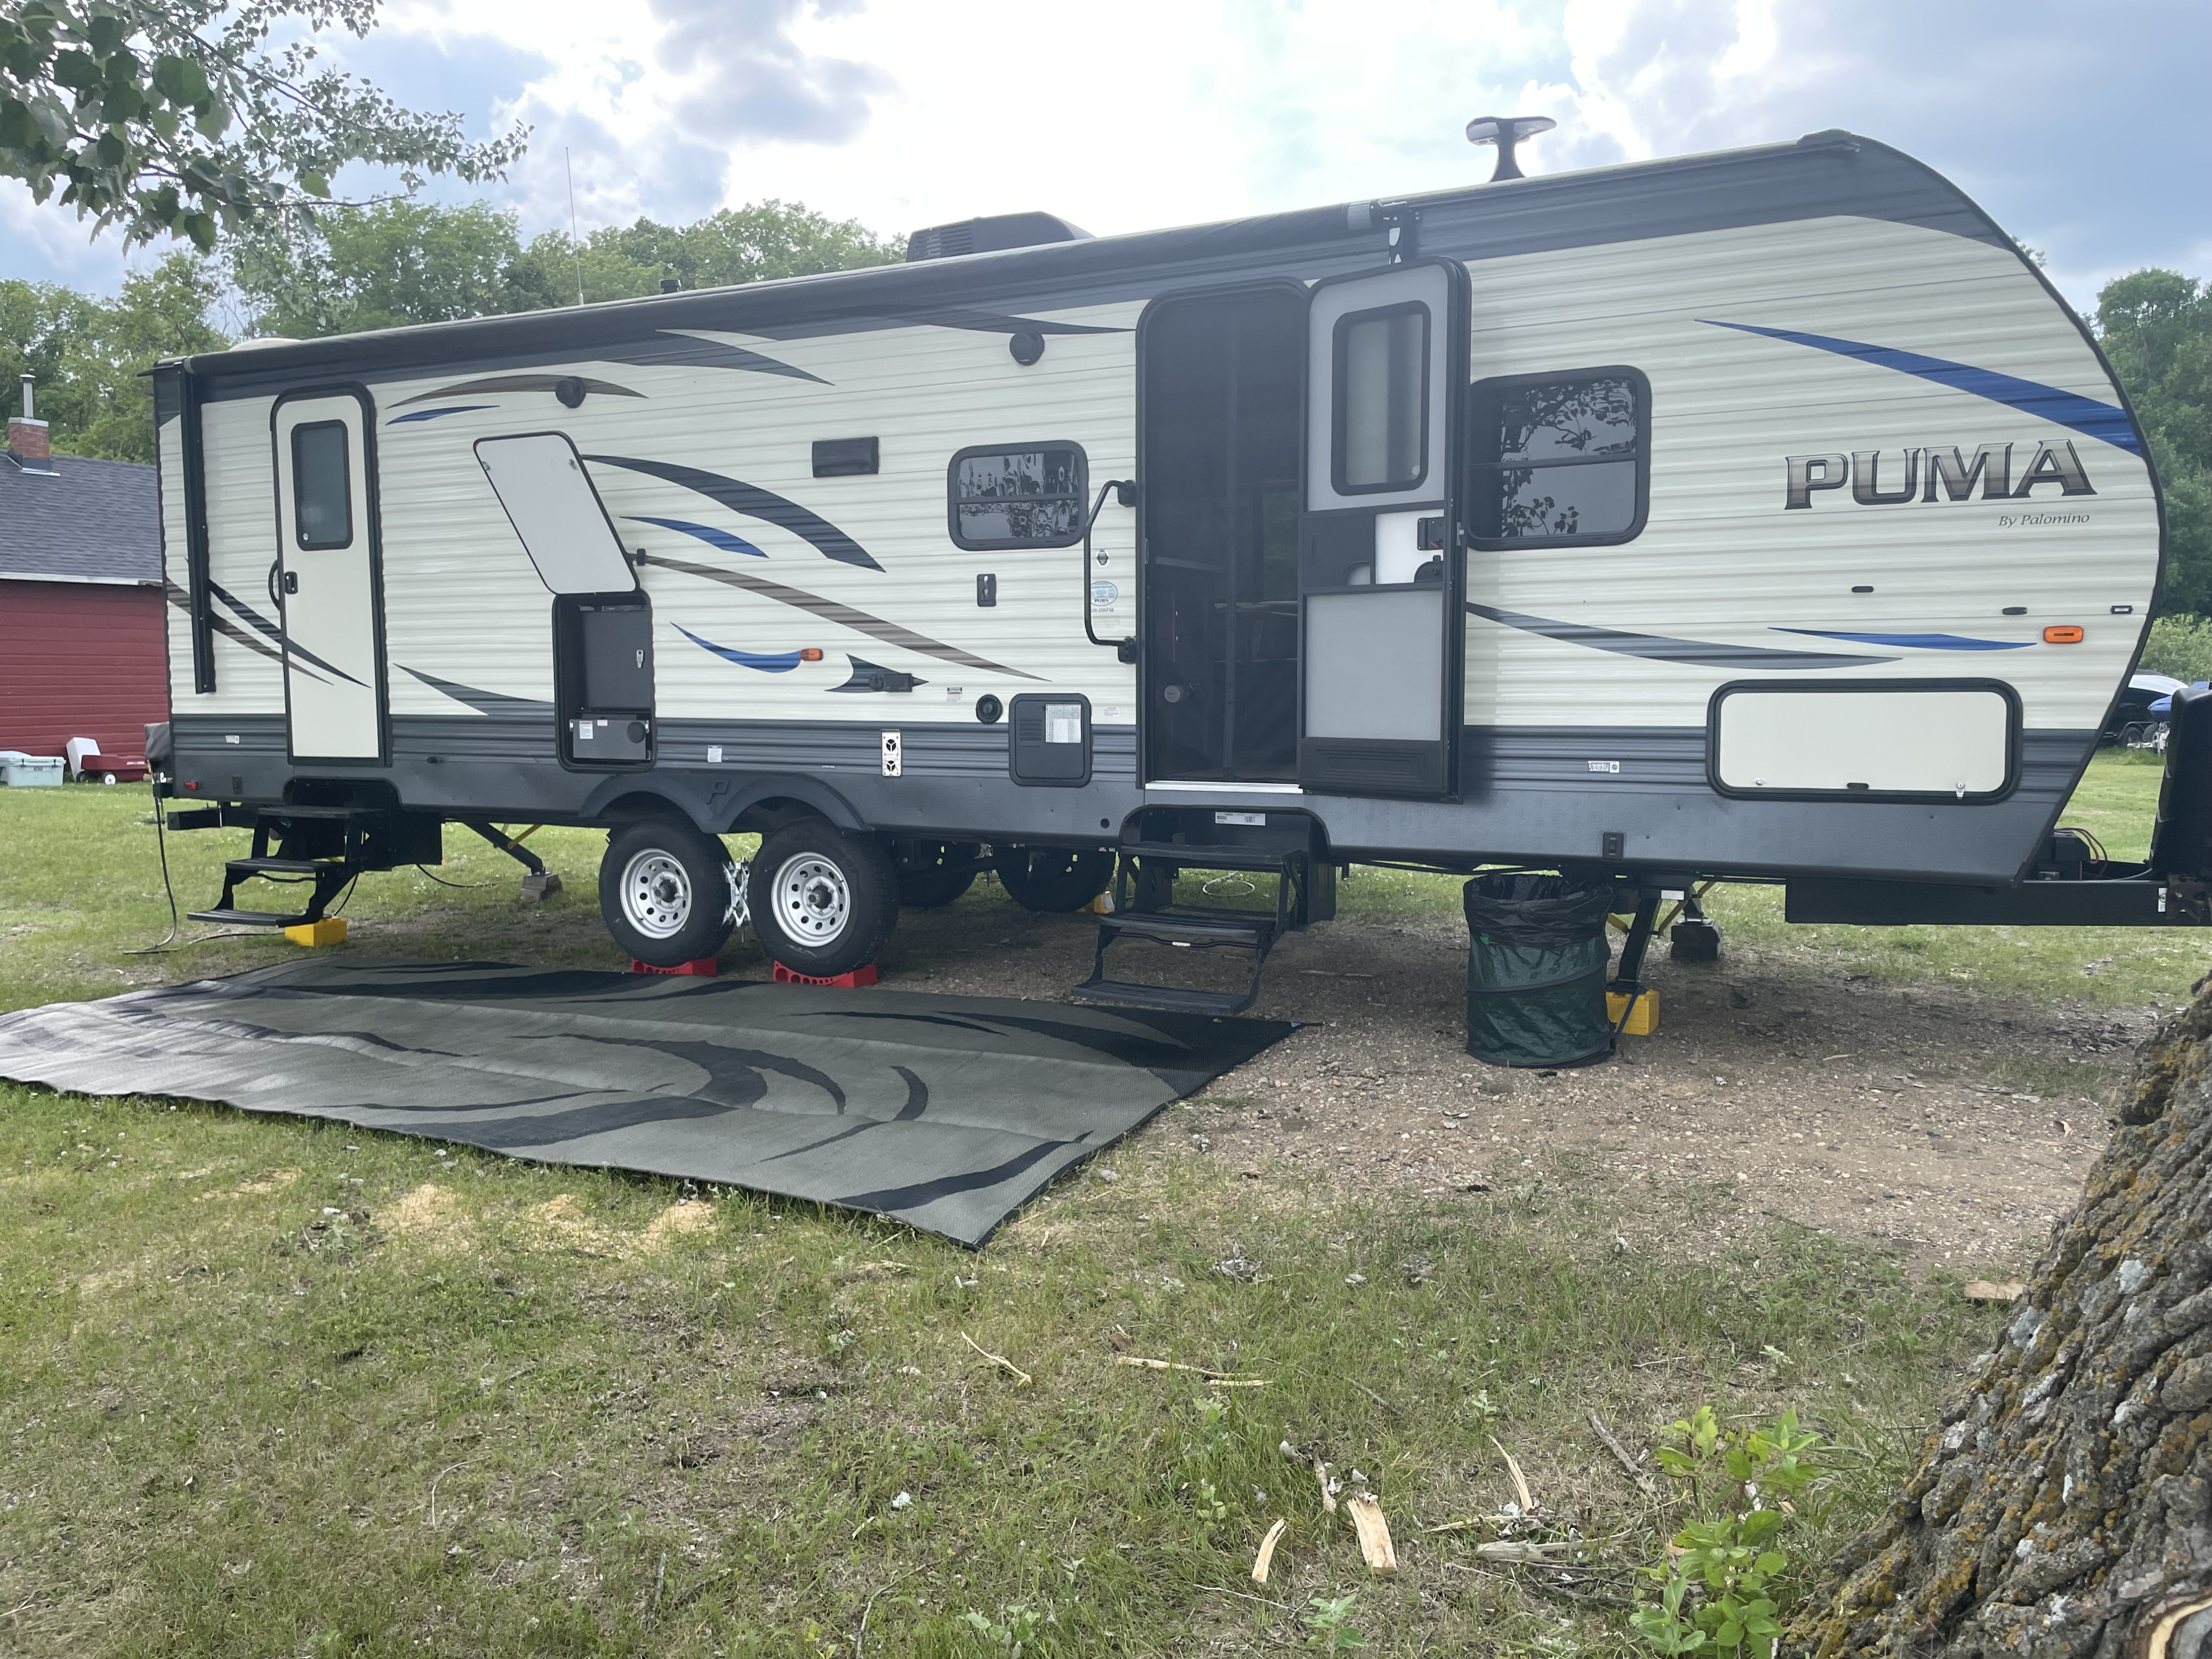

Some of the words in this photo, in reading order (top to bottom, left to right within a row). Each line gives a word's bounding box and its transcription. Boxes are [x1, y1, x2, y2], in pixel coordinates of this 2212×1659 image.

[1784, 439, 2098, 510] PUMA
[1999, 515, 2017, 528] By
[2021, 513, 2090, 525] Palomino
